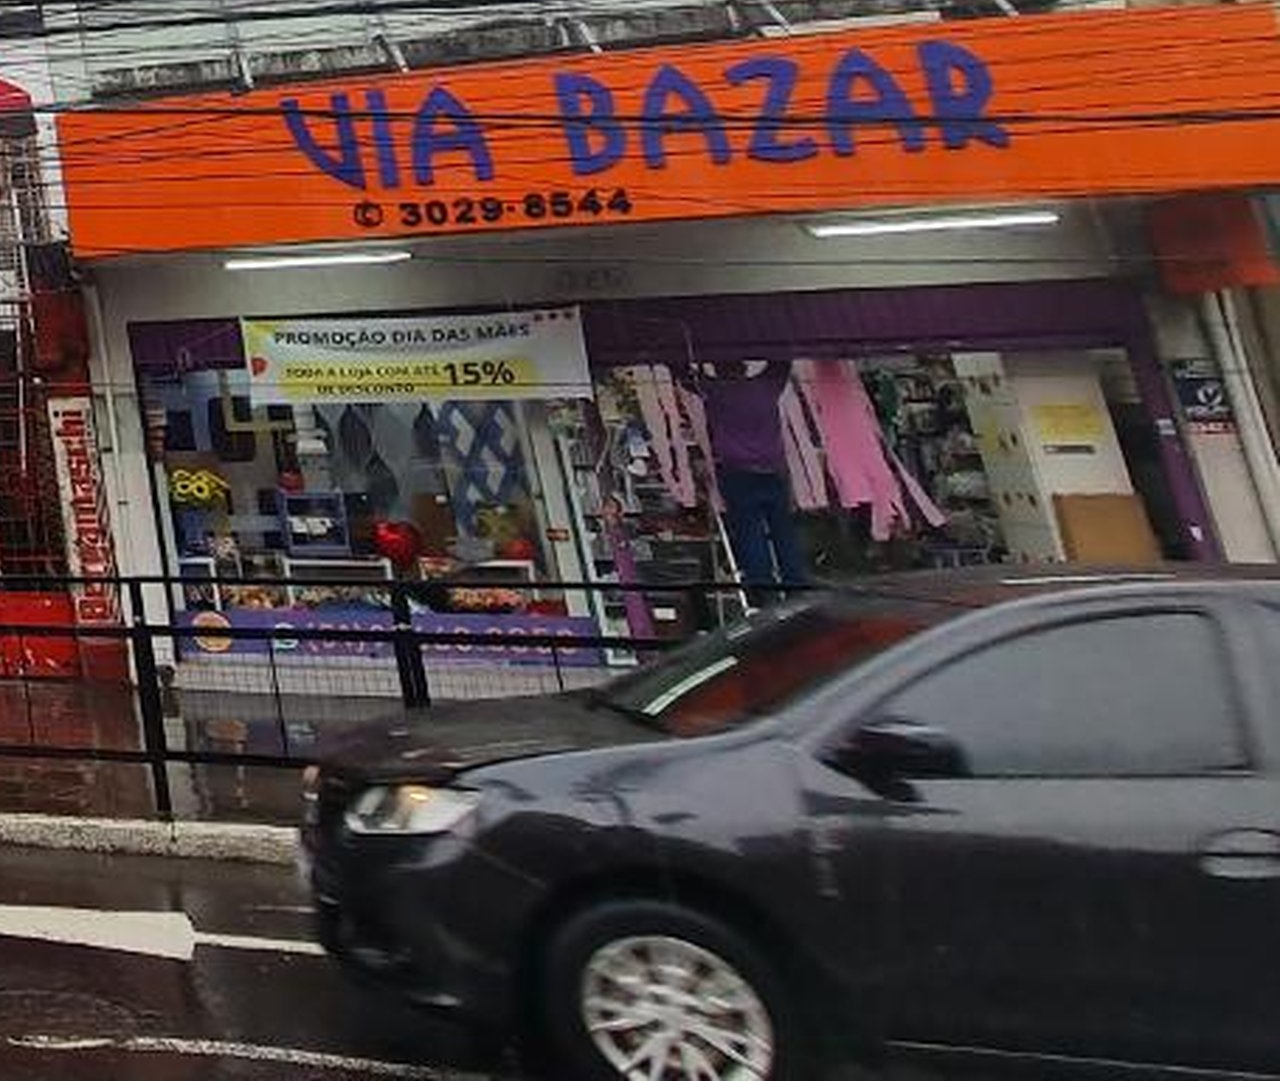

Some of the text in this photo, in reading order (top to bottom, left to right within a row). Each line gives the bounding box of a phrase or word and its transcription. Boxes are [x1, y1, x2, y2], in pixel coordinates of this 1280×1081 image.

[280, 38, 1012, 191] VIA BAZAR
[400, 187, 633, 228] 3029-8544
[392, 329, 427, 344] DIA
[432, 327, 472, 343] DAS
[442, 360, 516, 387] 15%
